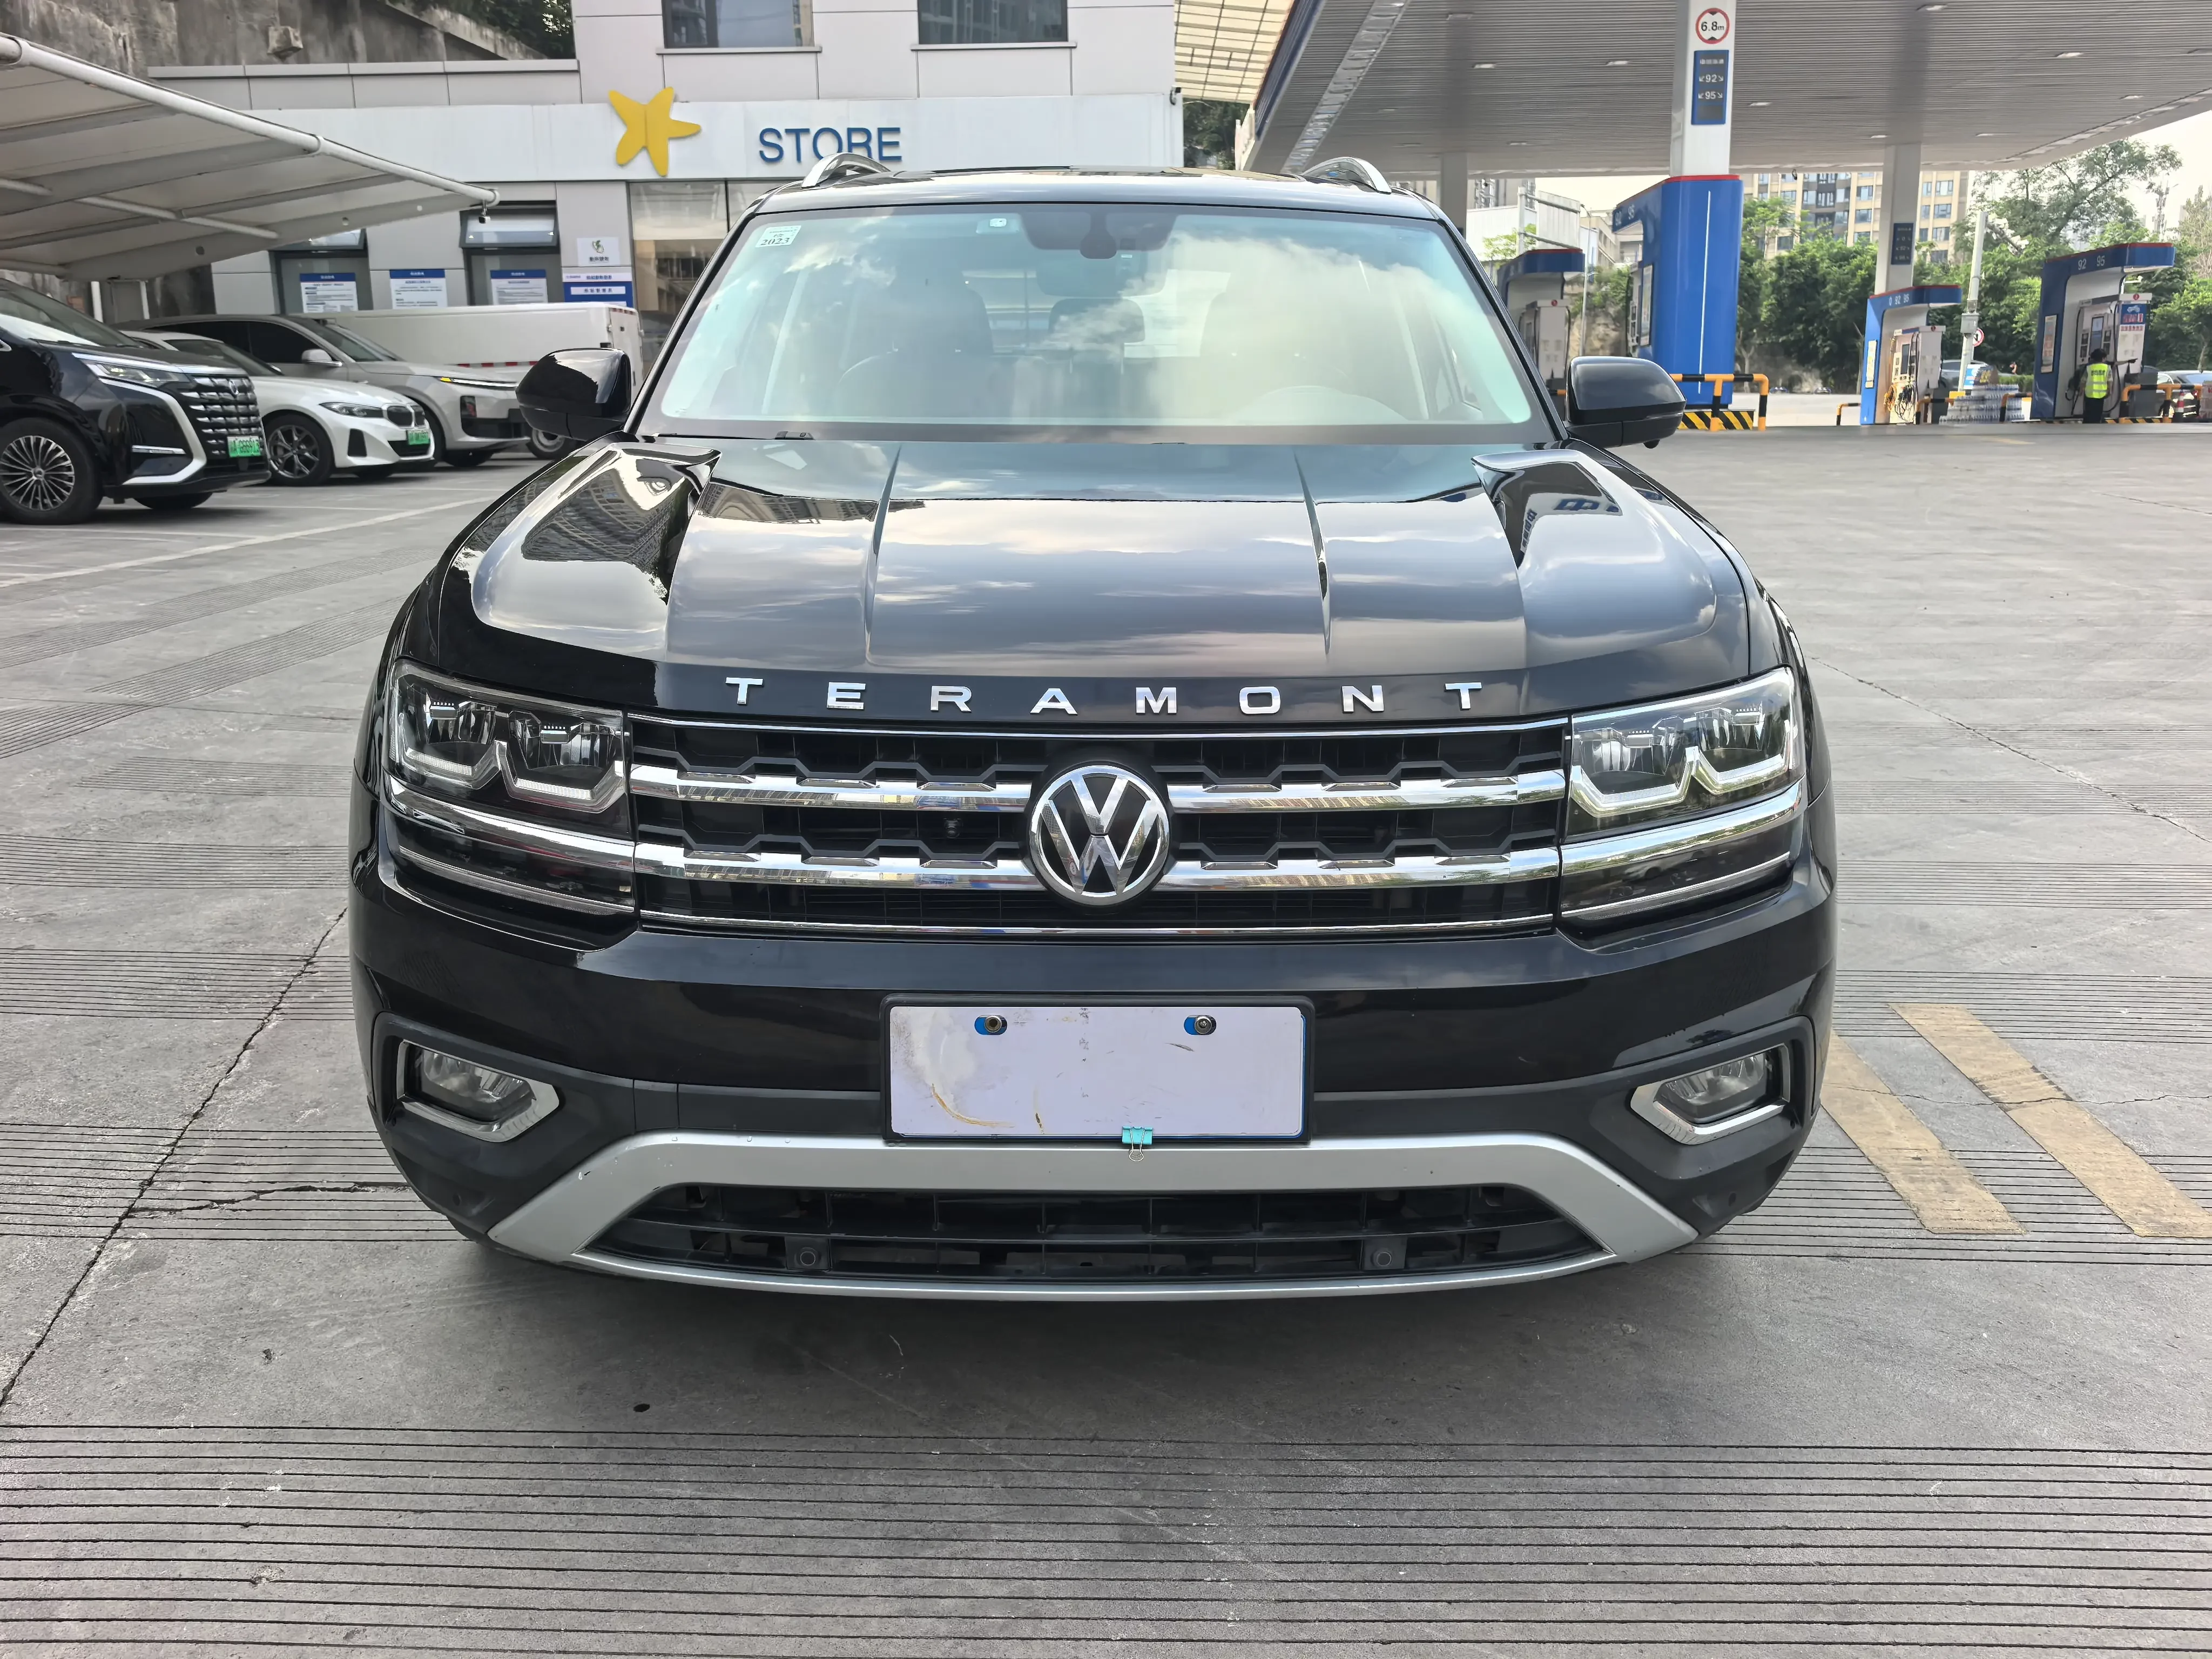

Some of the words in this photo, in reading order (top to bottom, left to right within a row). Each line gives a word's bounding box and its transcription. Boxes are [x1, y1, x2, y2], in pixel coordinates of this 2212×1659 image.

[1701, 21, 1724, 31] 6.8m
[1705, 74, 1717, 83] 92
[1705, 91, 1717, 99] 95
[759, 127, 902, 162] STORE
[760, 237, 790, 246] 2023
[2078, 258, 2087, 270] 92
[2096, 255, 2106, 267] 95
[726, 677, 1483, 716] TERAMONT
